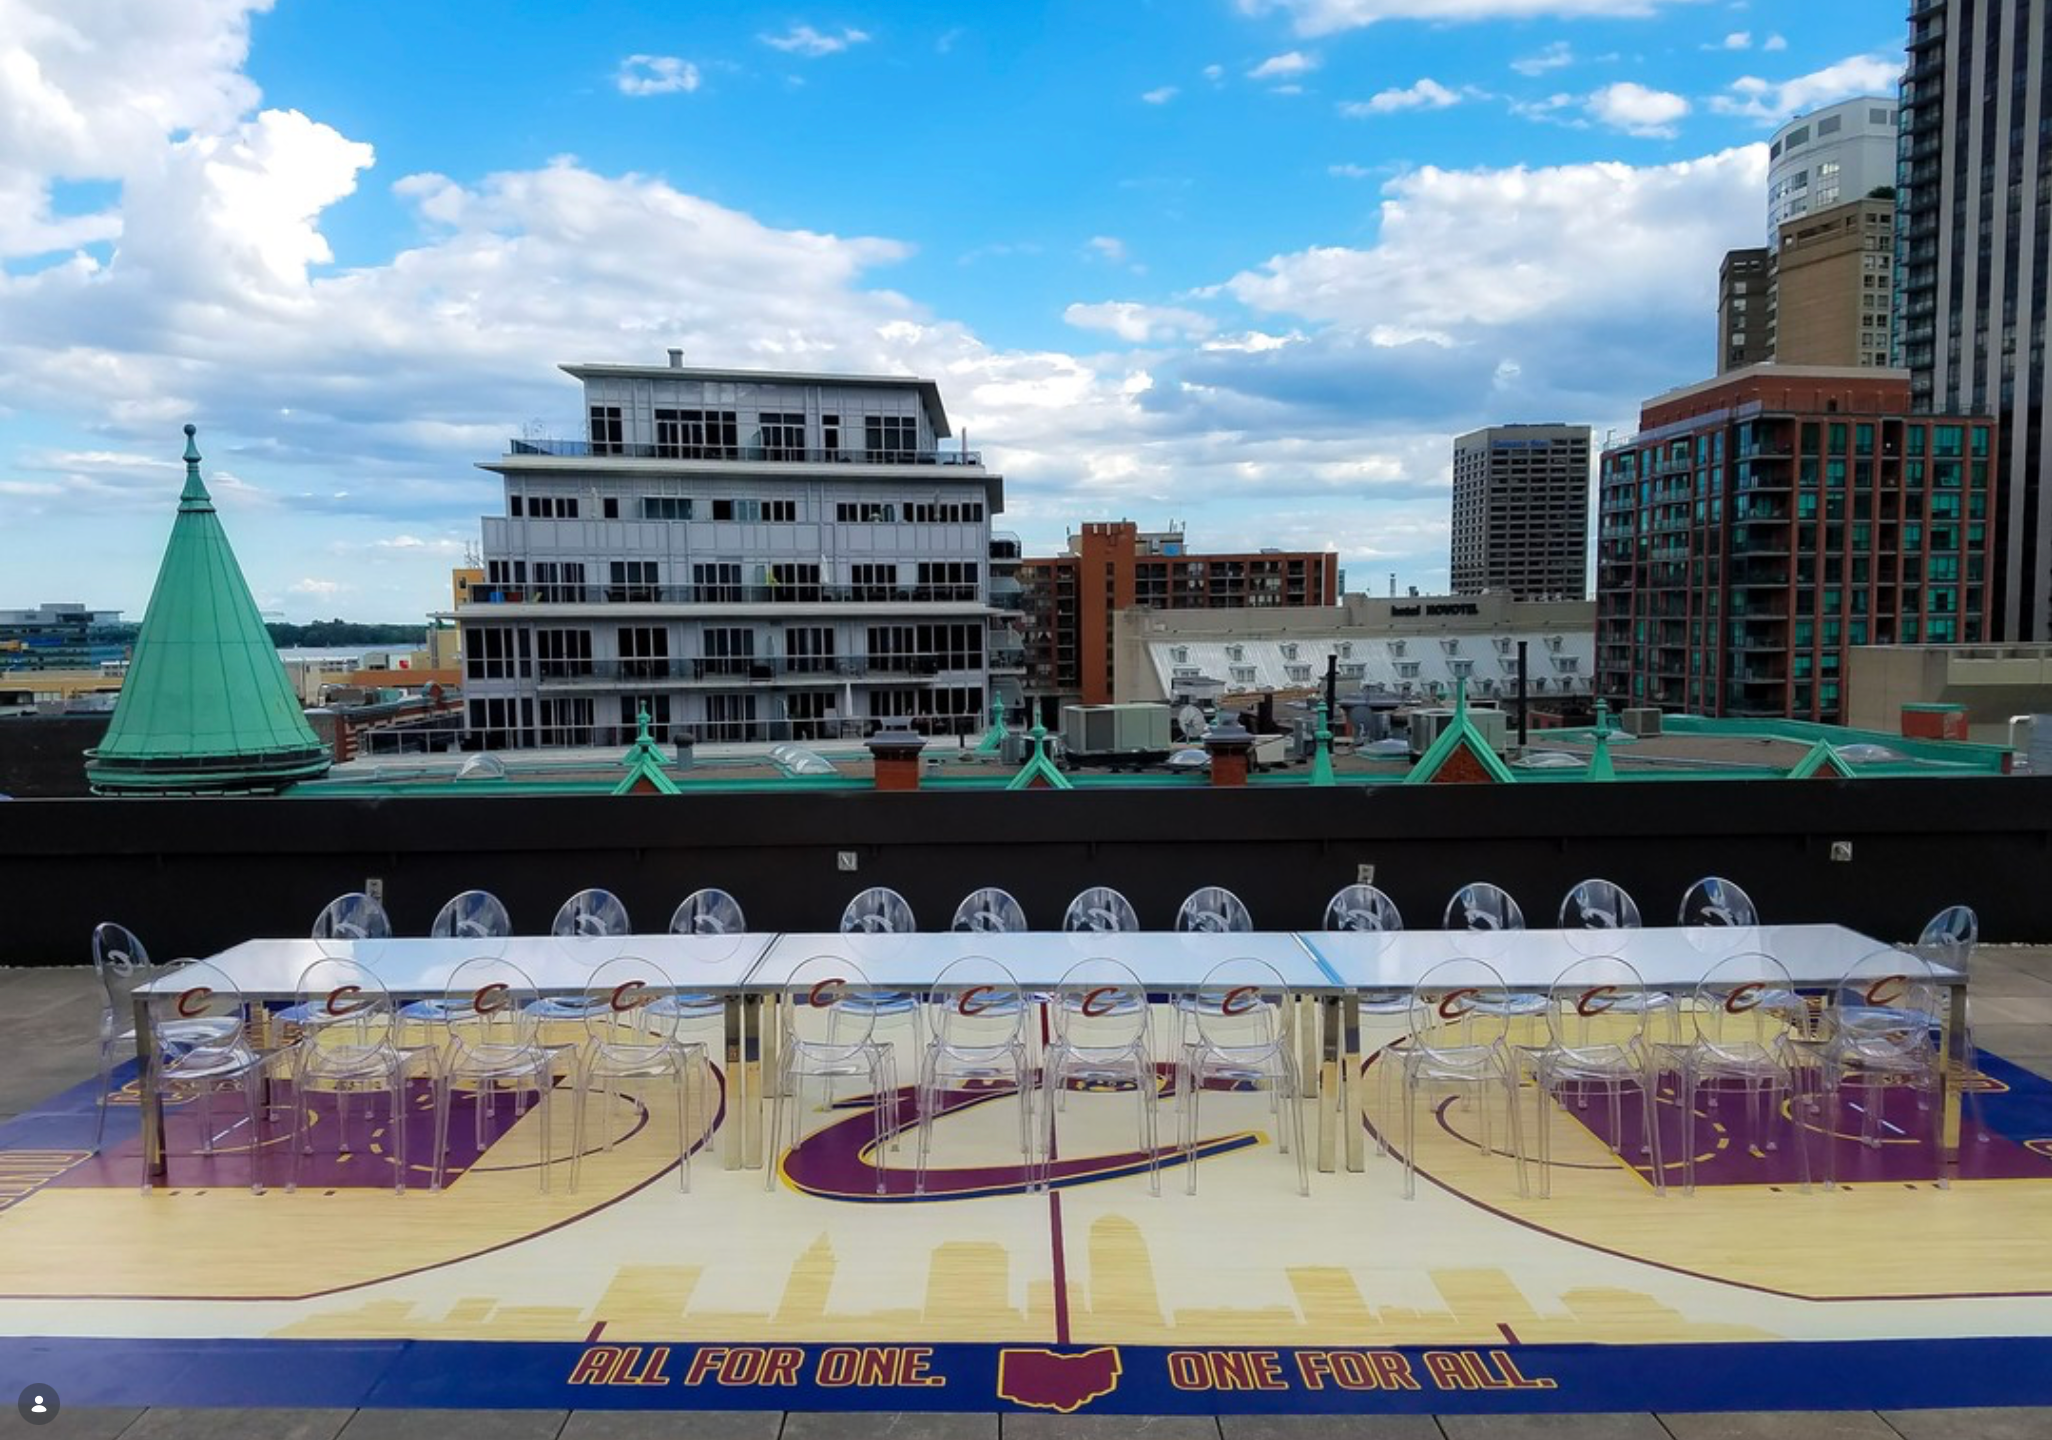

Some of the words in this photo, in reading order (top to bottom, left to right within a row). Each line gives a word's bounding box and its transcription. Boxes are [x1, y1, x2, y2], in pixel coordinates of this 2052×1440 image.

[1426, 603, 1479, 616] NOVOTEL
[567, 1347, 670, 1385] ALL
[684, 1348, 805, 1386] FOR
[815, 1348, 946, 1387] ONE.
[1167, 1350, 1288, 1390] ONE
[1294, 1351, 1421, 1390] FOR
[1422, 1351, 1558, 1389] ALL.
